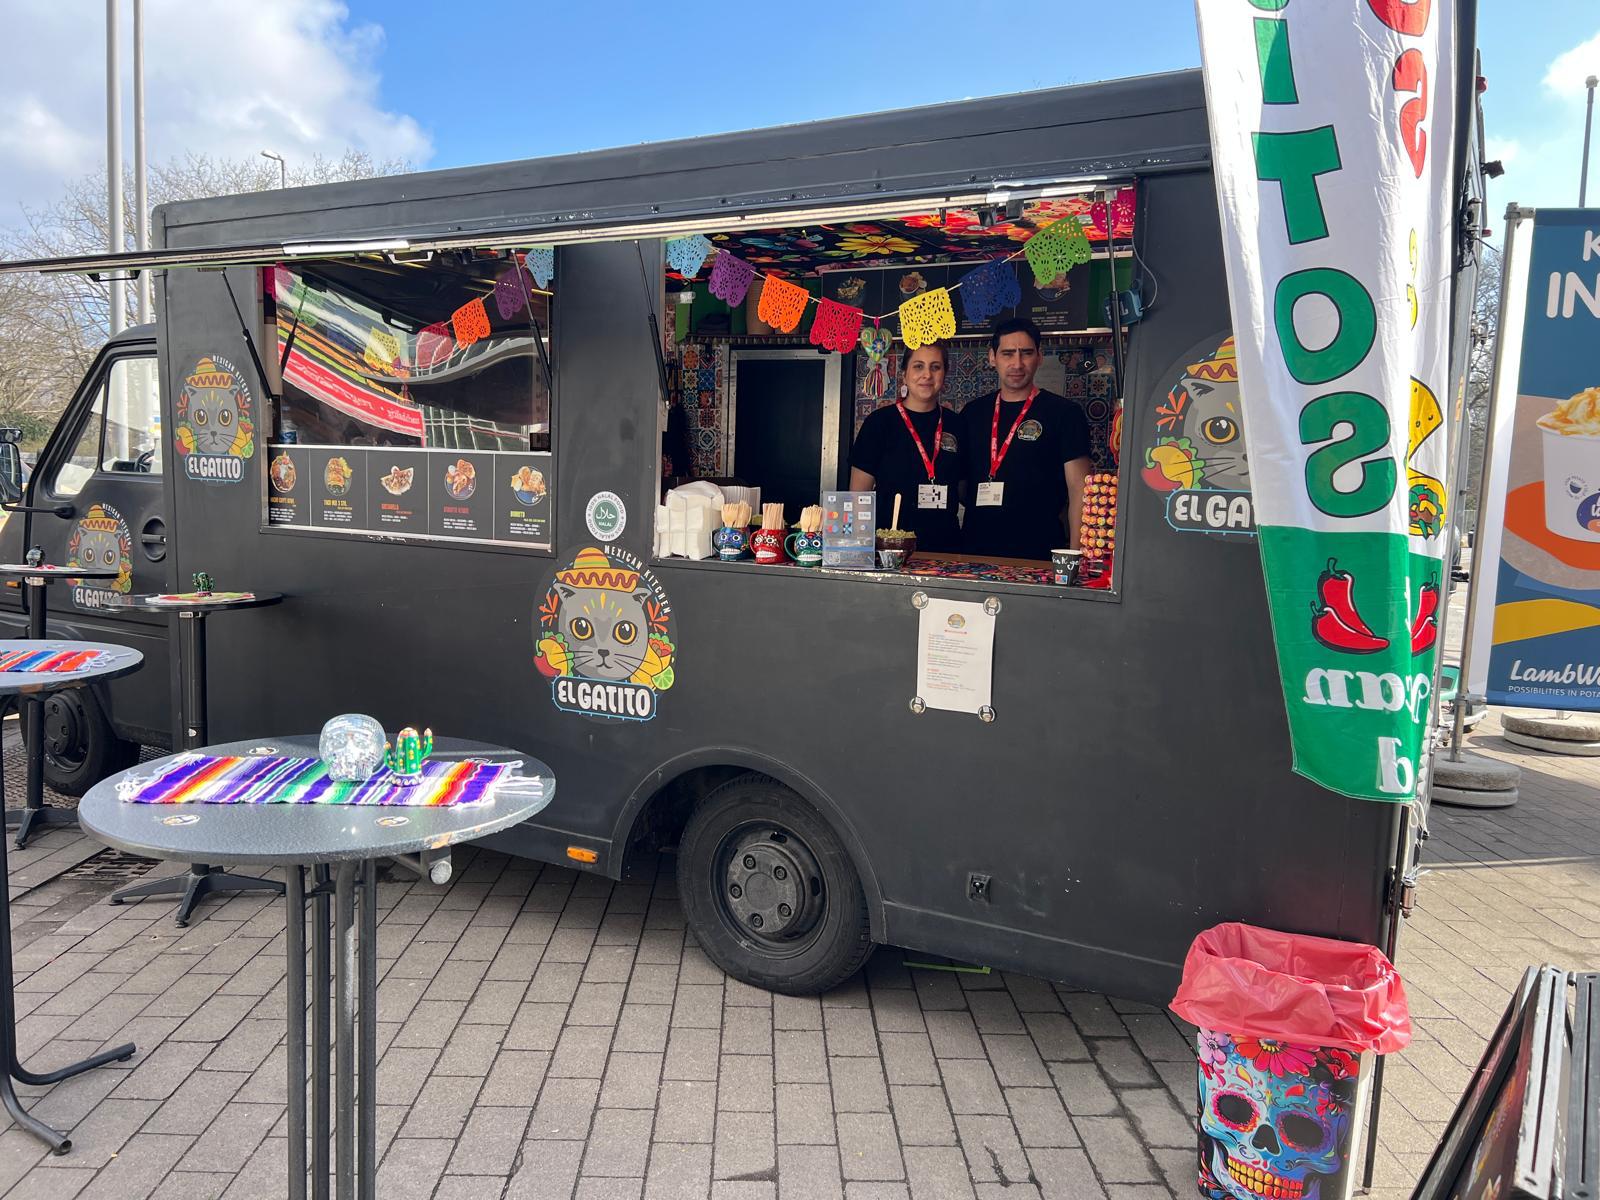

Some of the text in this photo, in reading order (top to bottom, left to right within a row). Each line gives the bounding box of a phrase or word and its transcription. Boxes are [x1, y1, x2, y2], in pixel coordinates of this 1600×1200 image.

[212, 354, 252, 403] MEXICAN KITCHEN
[188, 457, 241, 479] EL GATITO
[1175, 495, 1252, 528] EL GA
[604, 545, 672, 615] MEXICAN KITCHEN
[75, 588, 85, 604] EL
[1510, 659, 1600, 686] LambW
[557, 680, 651, 717] EL GATITO
[1508, 685, 1566, 696] POSSIBILITIES
[1567, 689, 1577, 697] IN
